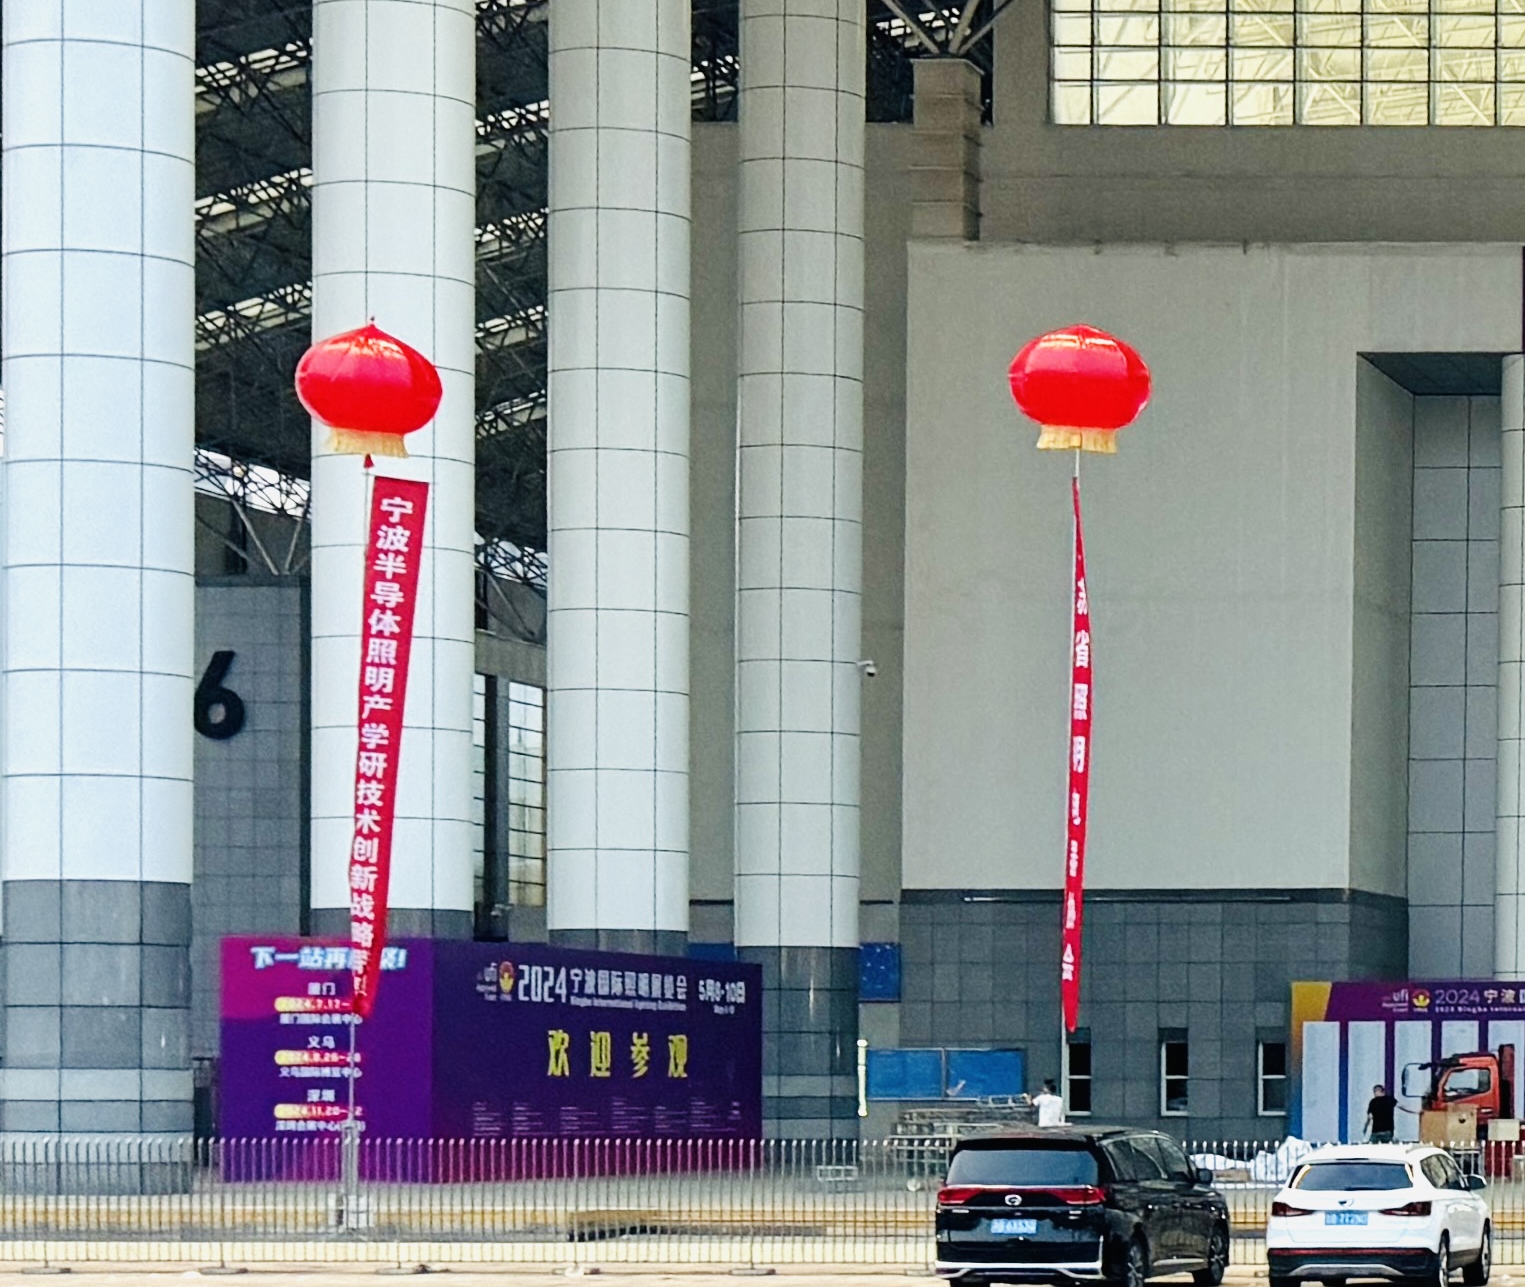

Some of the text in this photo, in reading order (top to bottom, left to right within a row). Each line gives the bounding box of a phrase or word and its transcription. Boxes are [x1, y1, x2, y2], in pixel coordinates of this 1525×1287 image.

[193, 650, 245, 741] 6
[349, 496, 414, 998] 宁波半导体照明产学研技术创新战略
